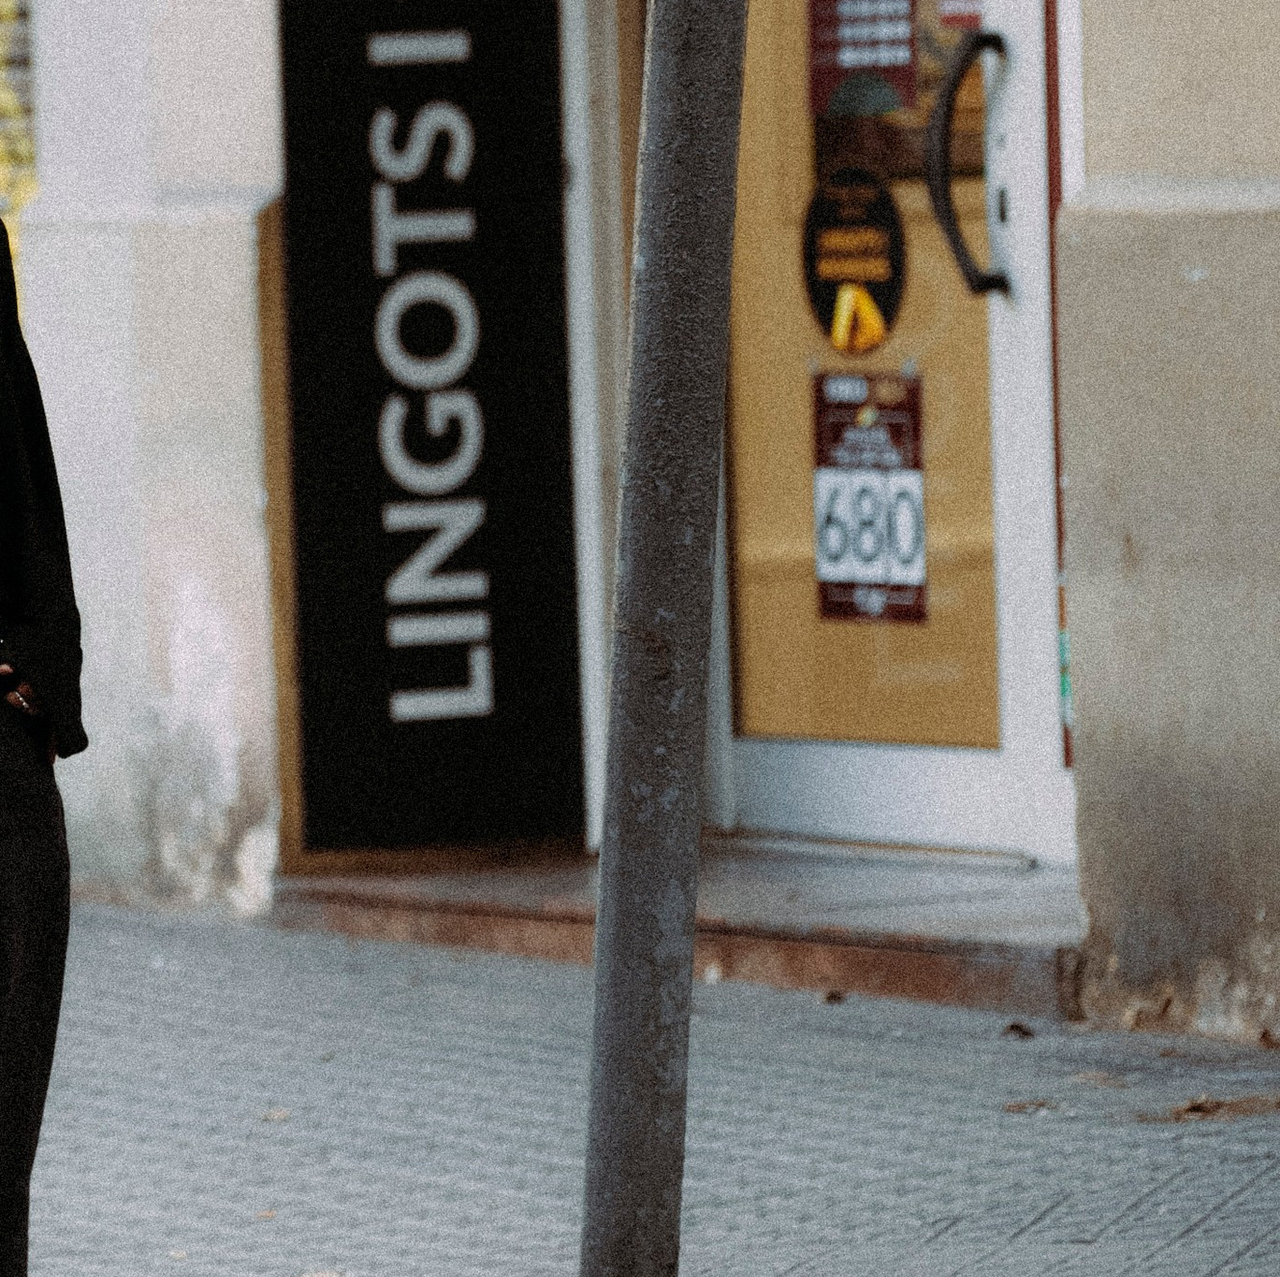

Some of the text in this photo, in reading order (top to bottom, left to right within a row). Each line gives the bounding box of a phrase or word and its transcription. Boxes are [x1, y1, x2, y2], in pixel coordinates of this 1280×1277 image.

[367, 29, 472, 65] I
[371, 100, 495, 721] LINGOTS
[820, 485, 923, 564] 680
